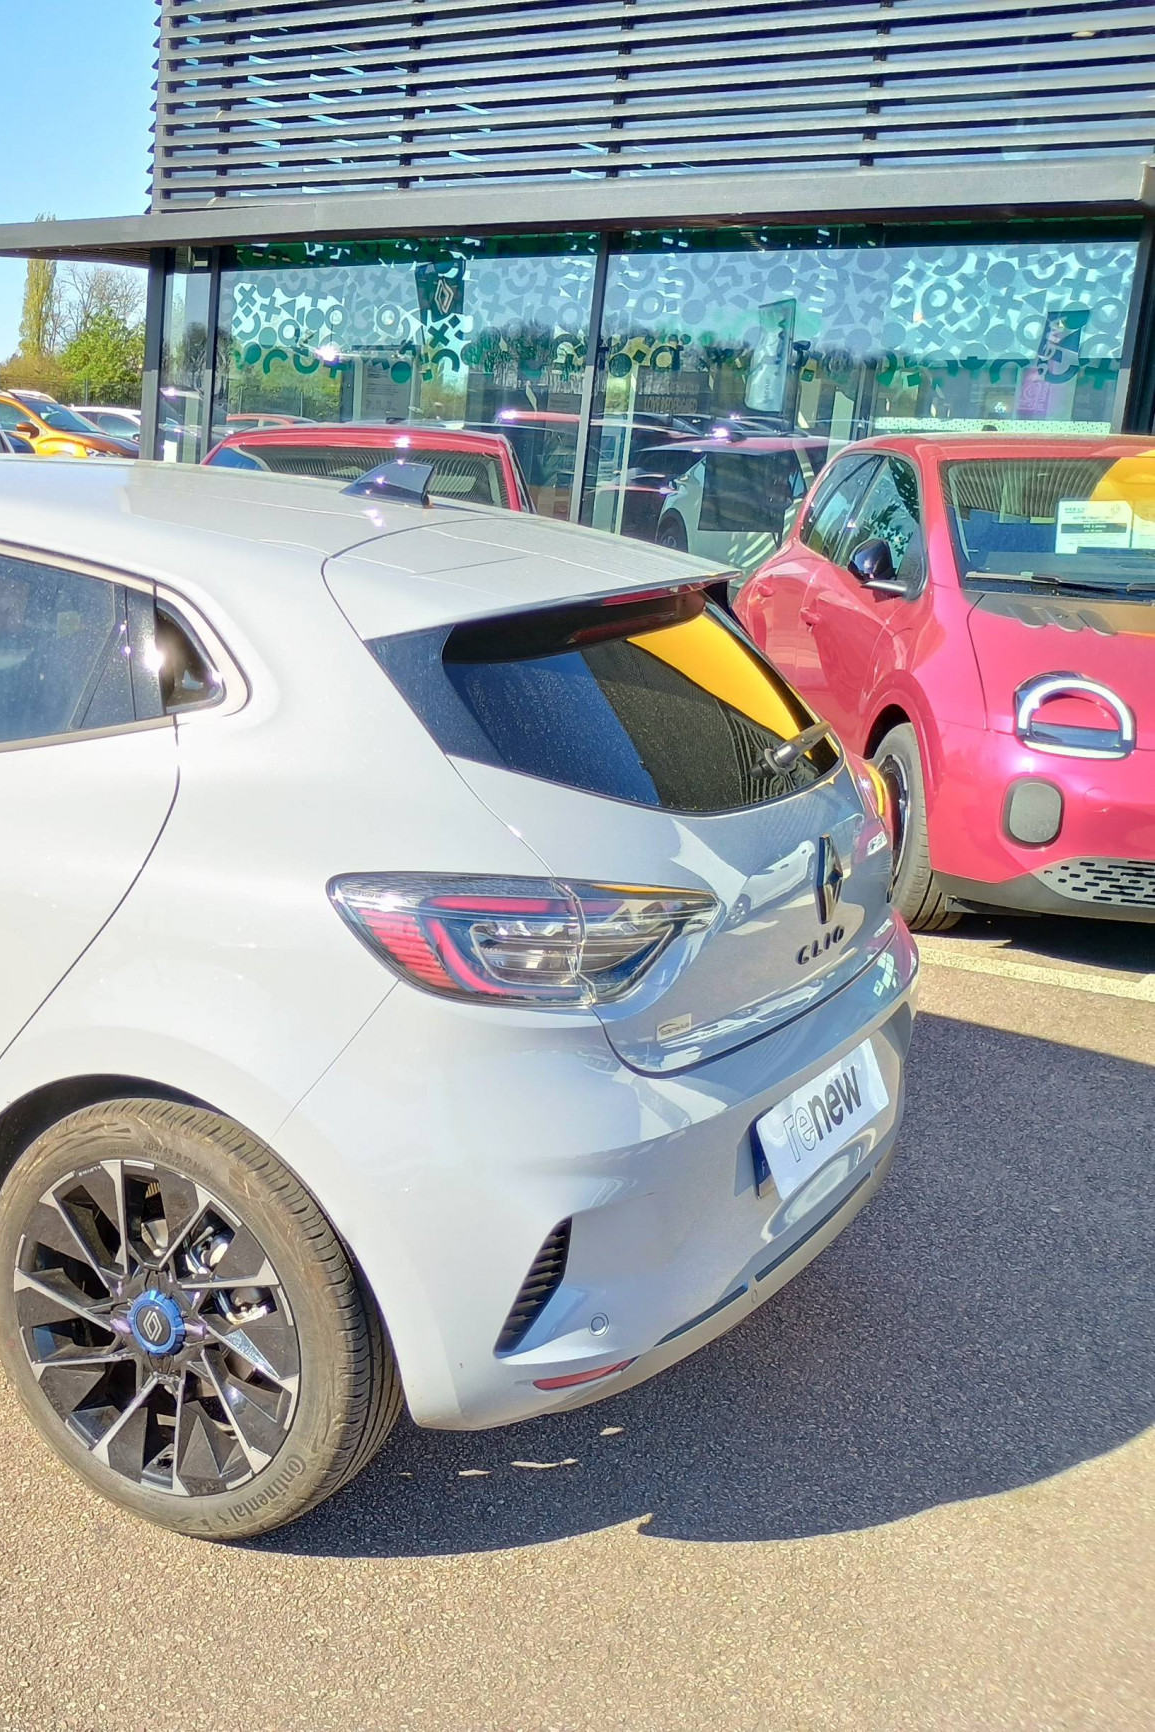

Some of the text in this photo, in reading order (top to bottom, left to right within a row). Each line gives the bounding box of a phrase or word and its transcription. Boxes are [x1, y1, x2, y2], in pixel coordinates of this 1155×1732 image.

[796, 925, 845, 966] CLIO
[783, 1065, 862, 1163] renew
[228, 1453, 307, 1523] Continental
